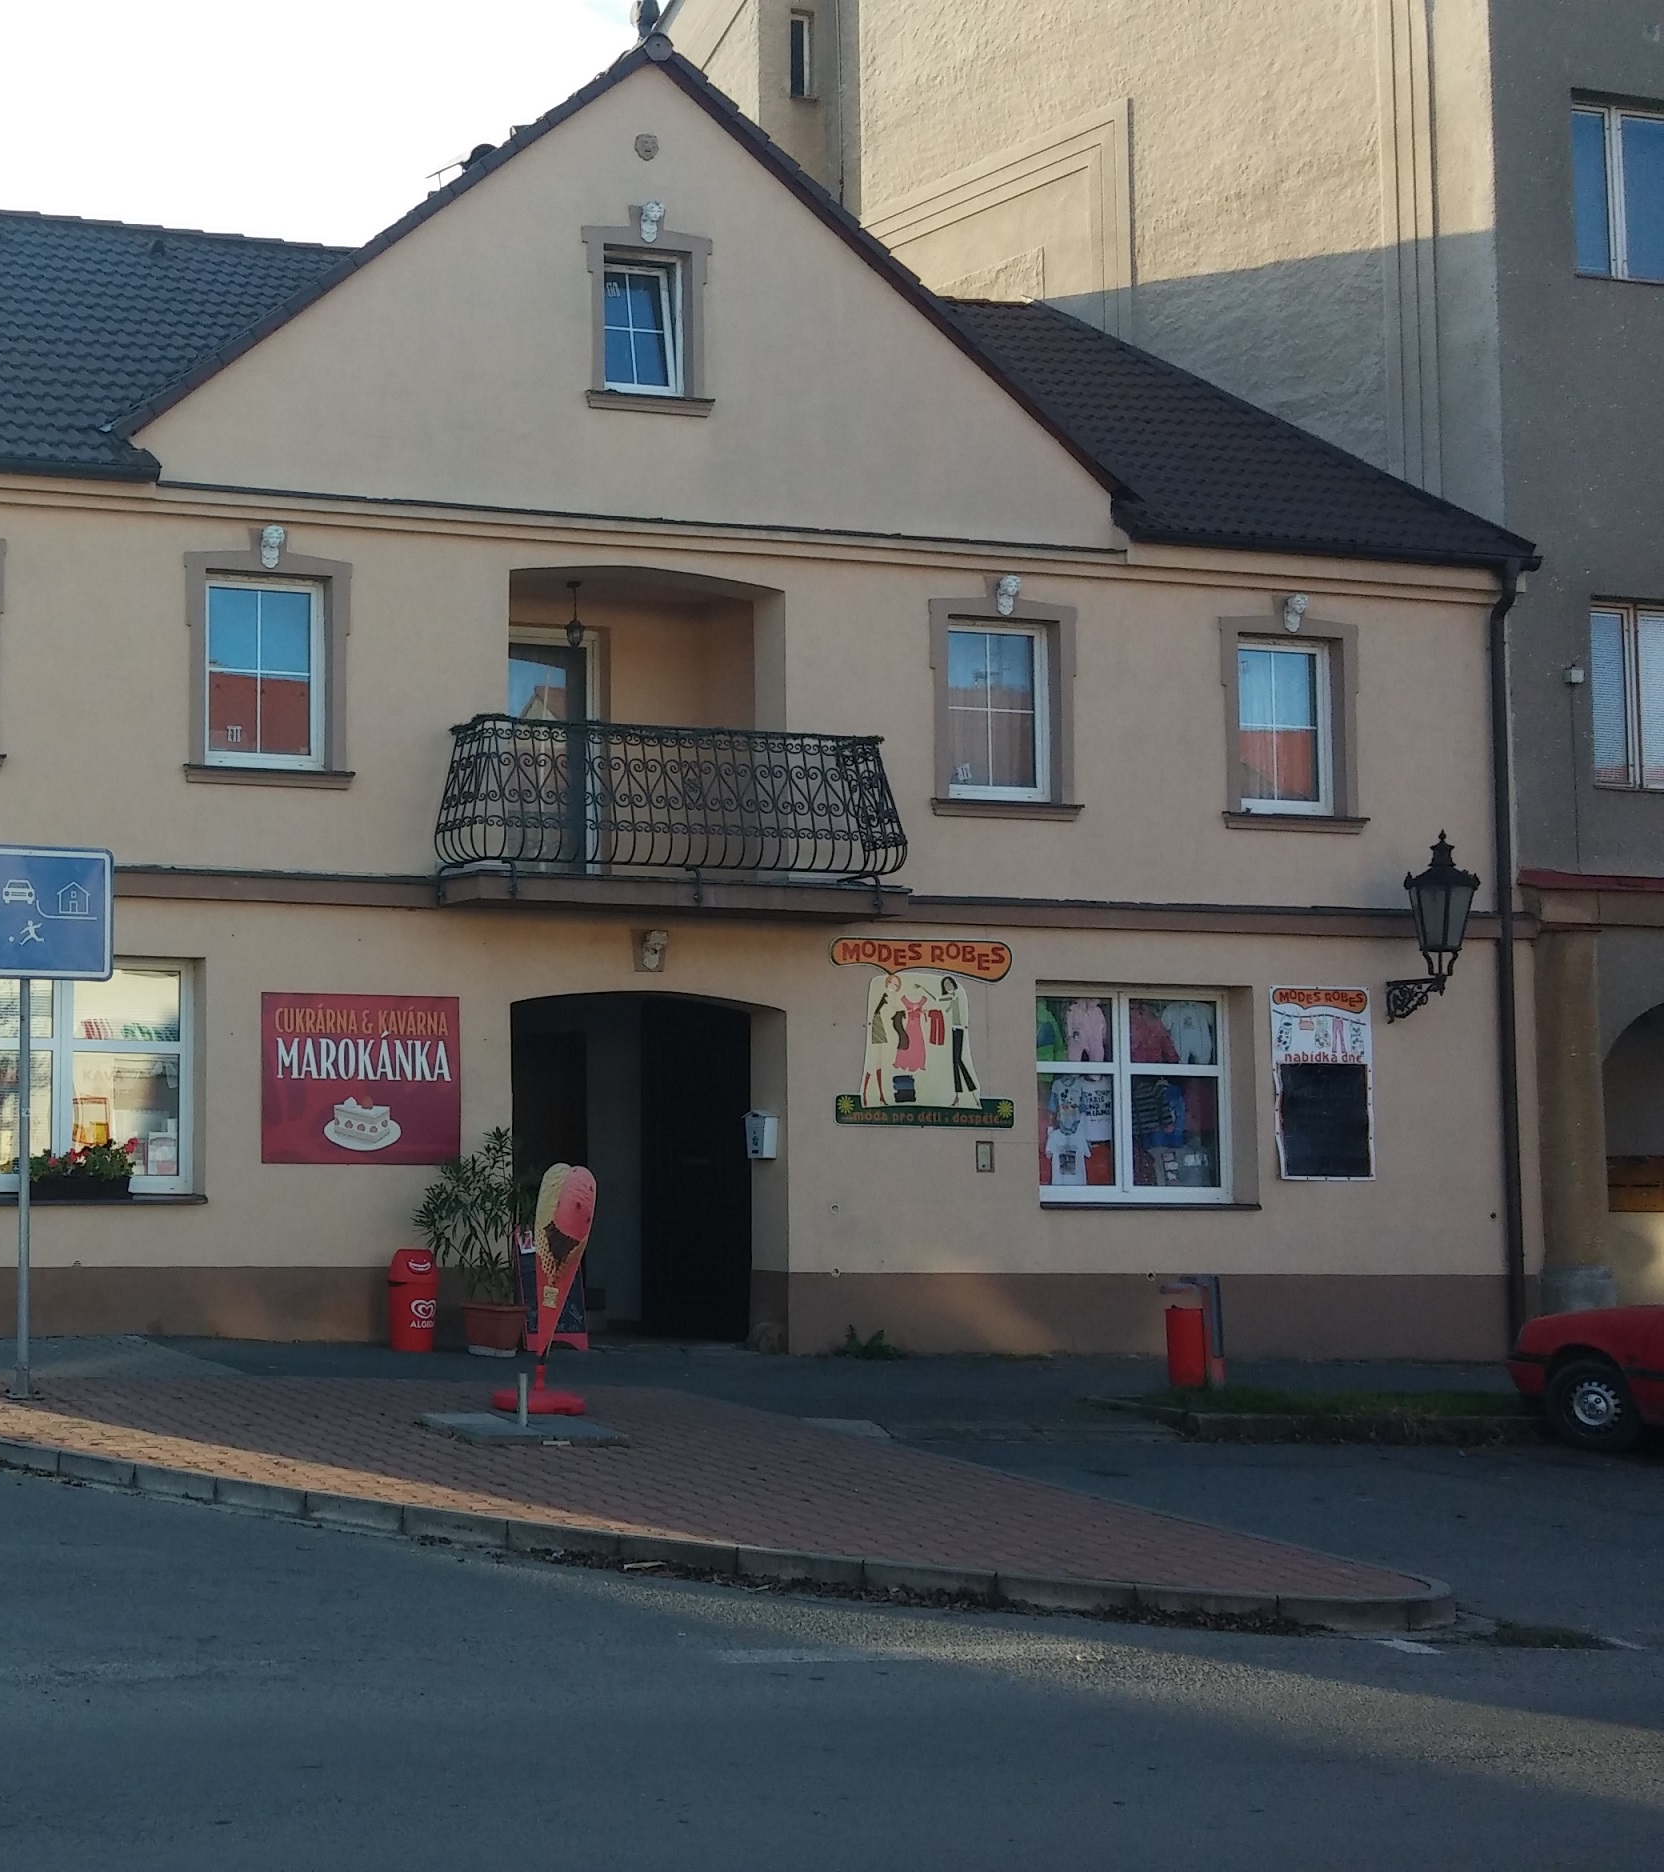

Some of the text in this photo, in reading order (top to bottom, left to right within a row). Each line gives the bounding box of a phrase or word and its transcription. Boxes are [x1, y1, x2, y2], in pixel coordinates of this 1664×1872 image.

[841, 940, 1006, 971] MODES ROBES
[1279, 990, 1364, 1007] MODES ROBES
[275, 1003, 449, 1036] CUKRÁRNA & KAVÁRNA
[276, 1030, 451, 1081] MAROKÁNKA
[1284, 1051, 1338, 1063] nabídka
[892, 1112, 915, 1123] pro
